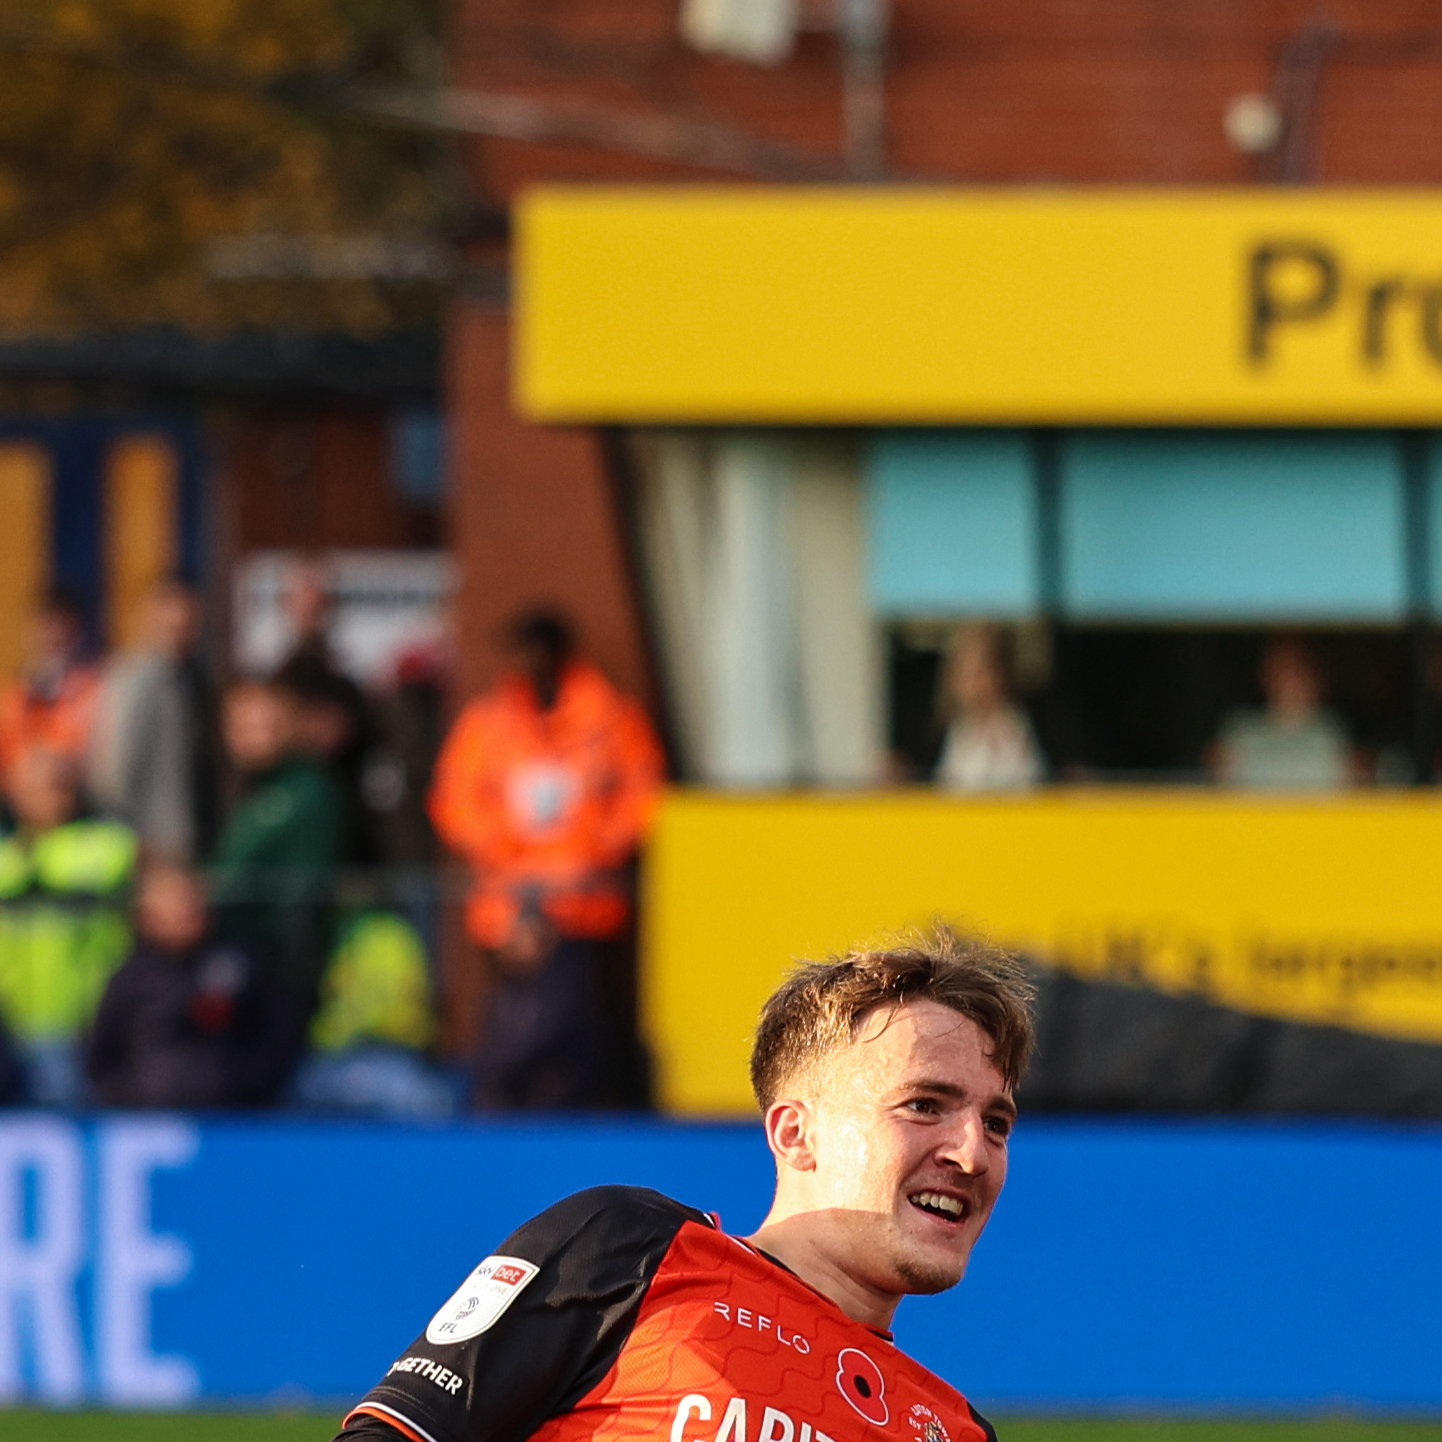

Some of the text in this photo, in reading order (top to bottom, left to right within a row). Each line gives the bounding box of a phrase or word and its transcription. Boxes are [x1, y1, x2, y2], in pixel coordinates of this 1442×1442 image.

[496, 1265, 521, 1283] bet
[438, 1322, 458, 1334] EFL
[713, 1301, 811, 1355] REFLO
